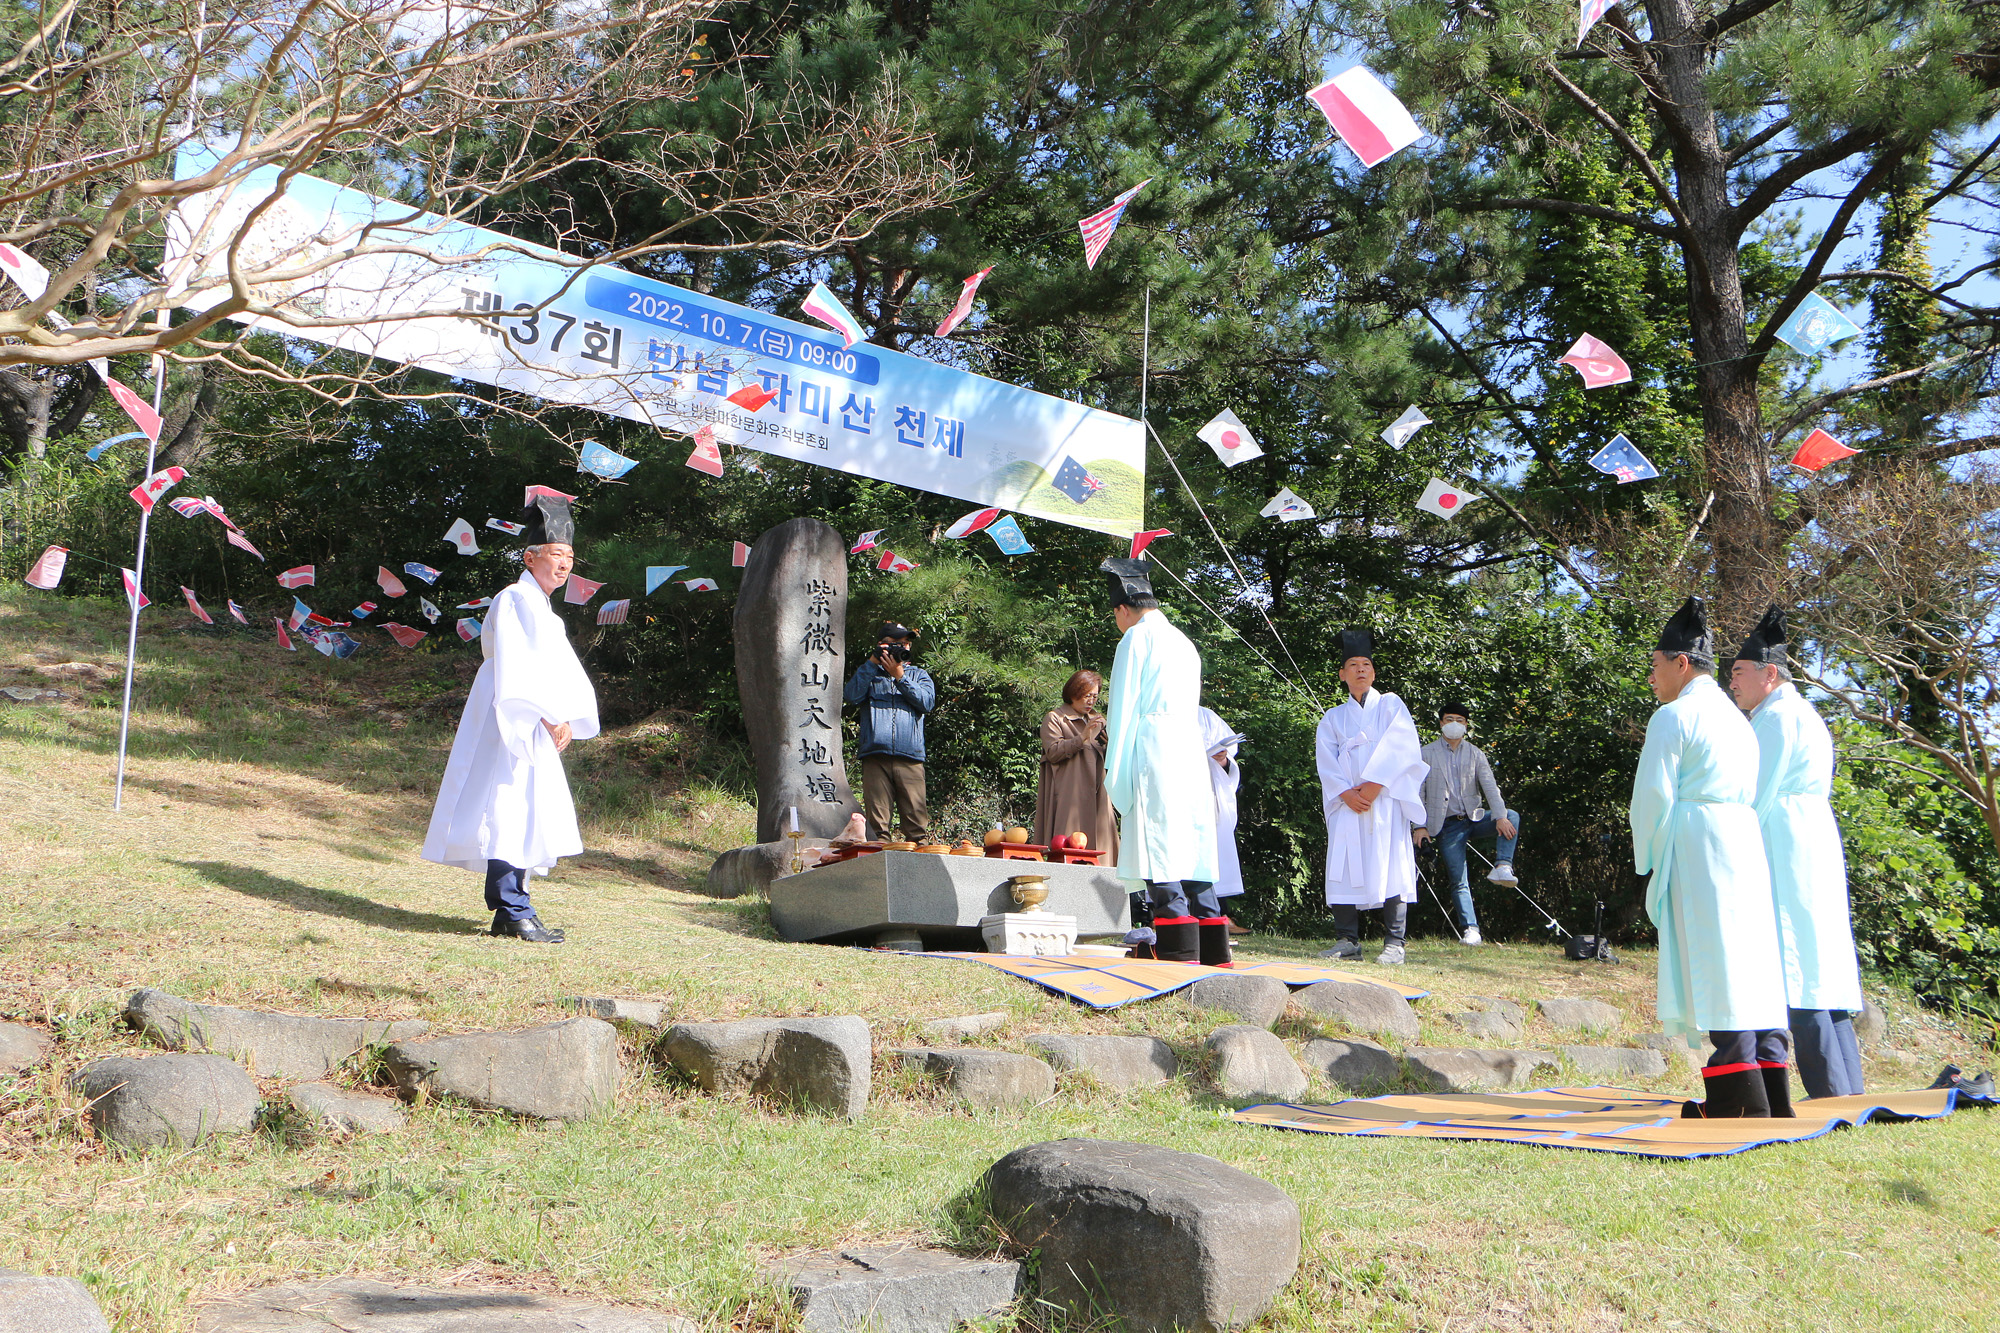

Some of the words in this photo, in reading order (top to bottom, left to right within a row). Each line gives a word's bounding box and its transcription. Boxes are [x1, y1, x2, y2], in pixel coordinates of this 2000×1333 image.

[457, 287, 622, 369] 제37회
[648, 338, 734, 397] 반남
[756, 368, 876, 435] 자미산
[894, 405, 965, 458] 천제
[627, 292, 690, 328] 2022.
[700, 313, 731, 341] 10.
[800, 341, 857, 374] 09:00
[799, 579, 844, 805] 紫微山天地壇
